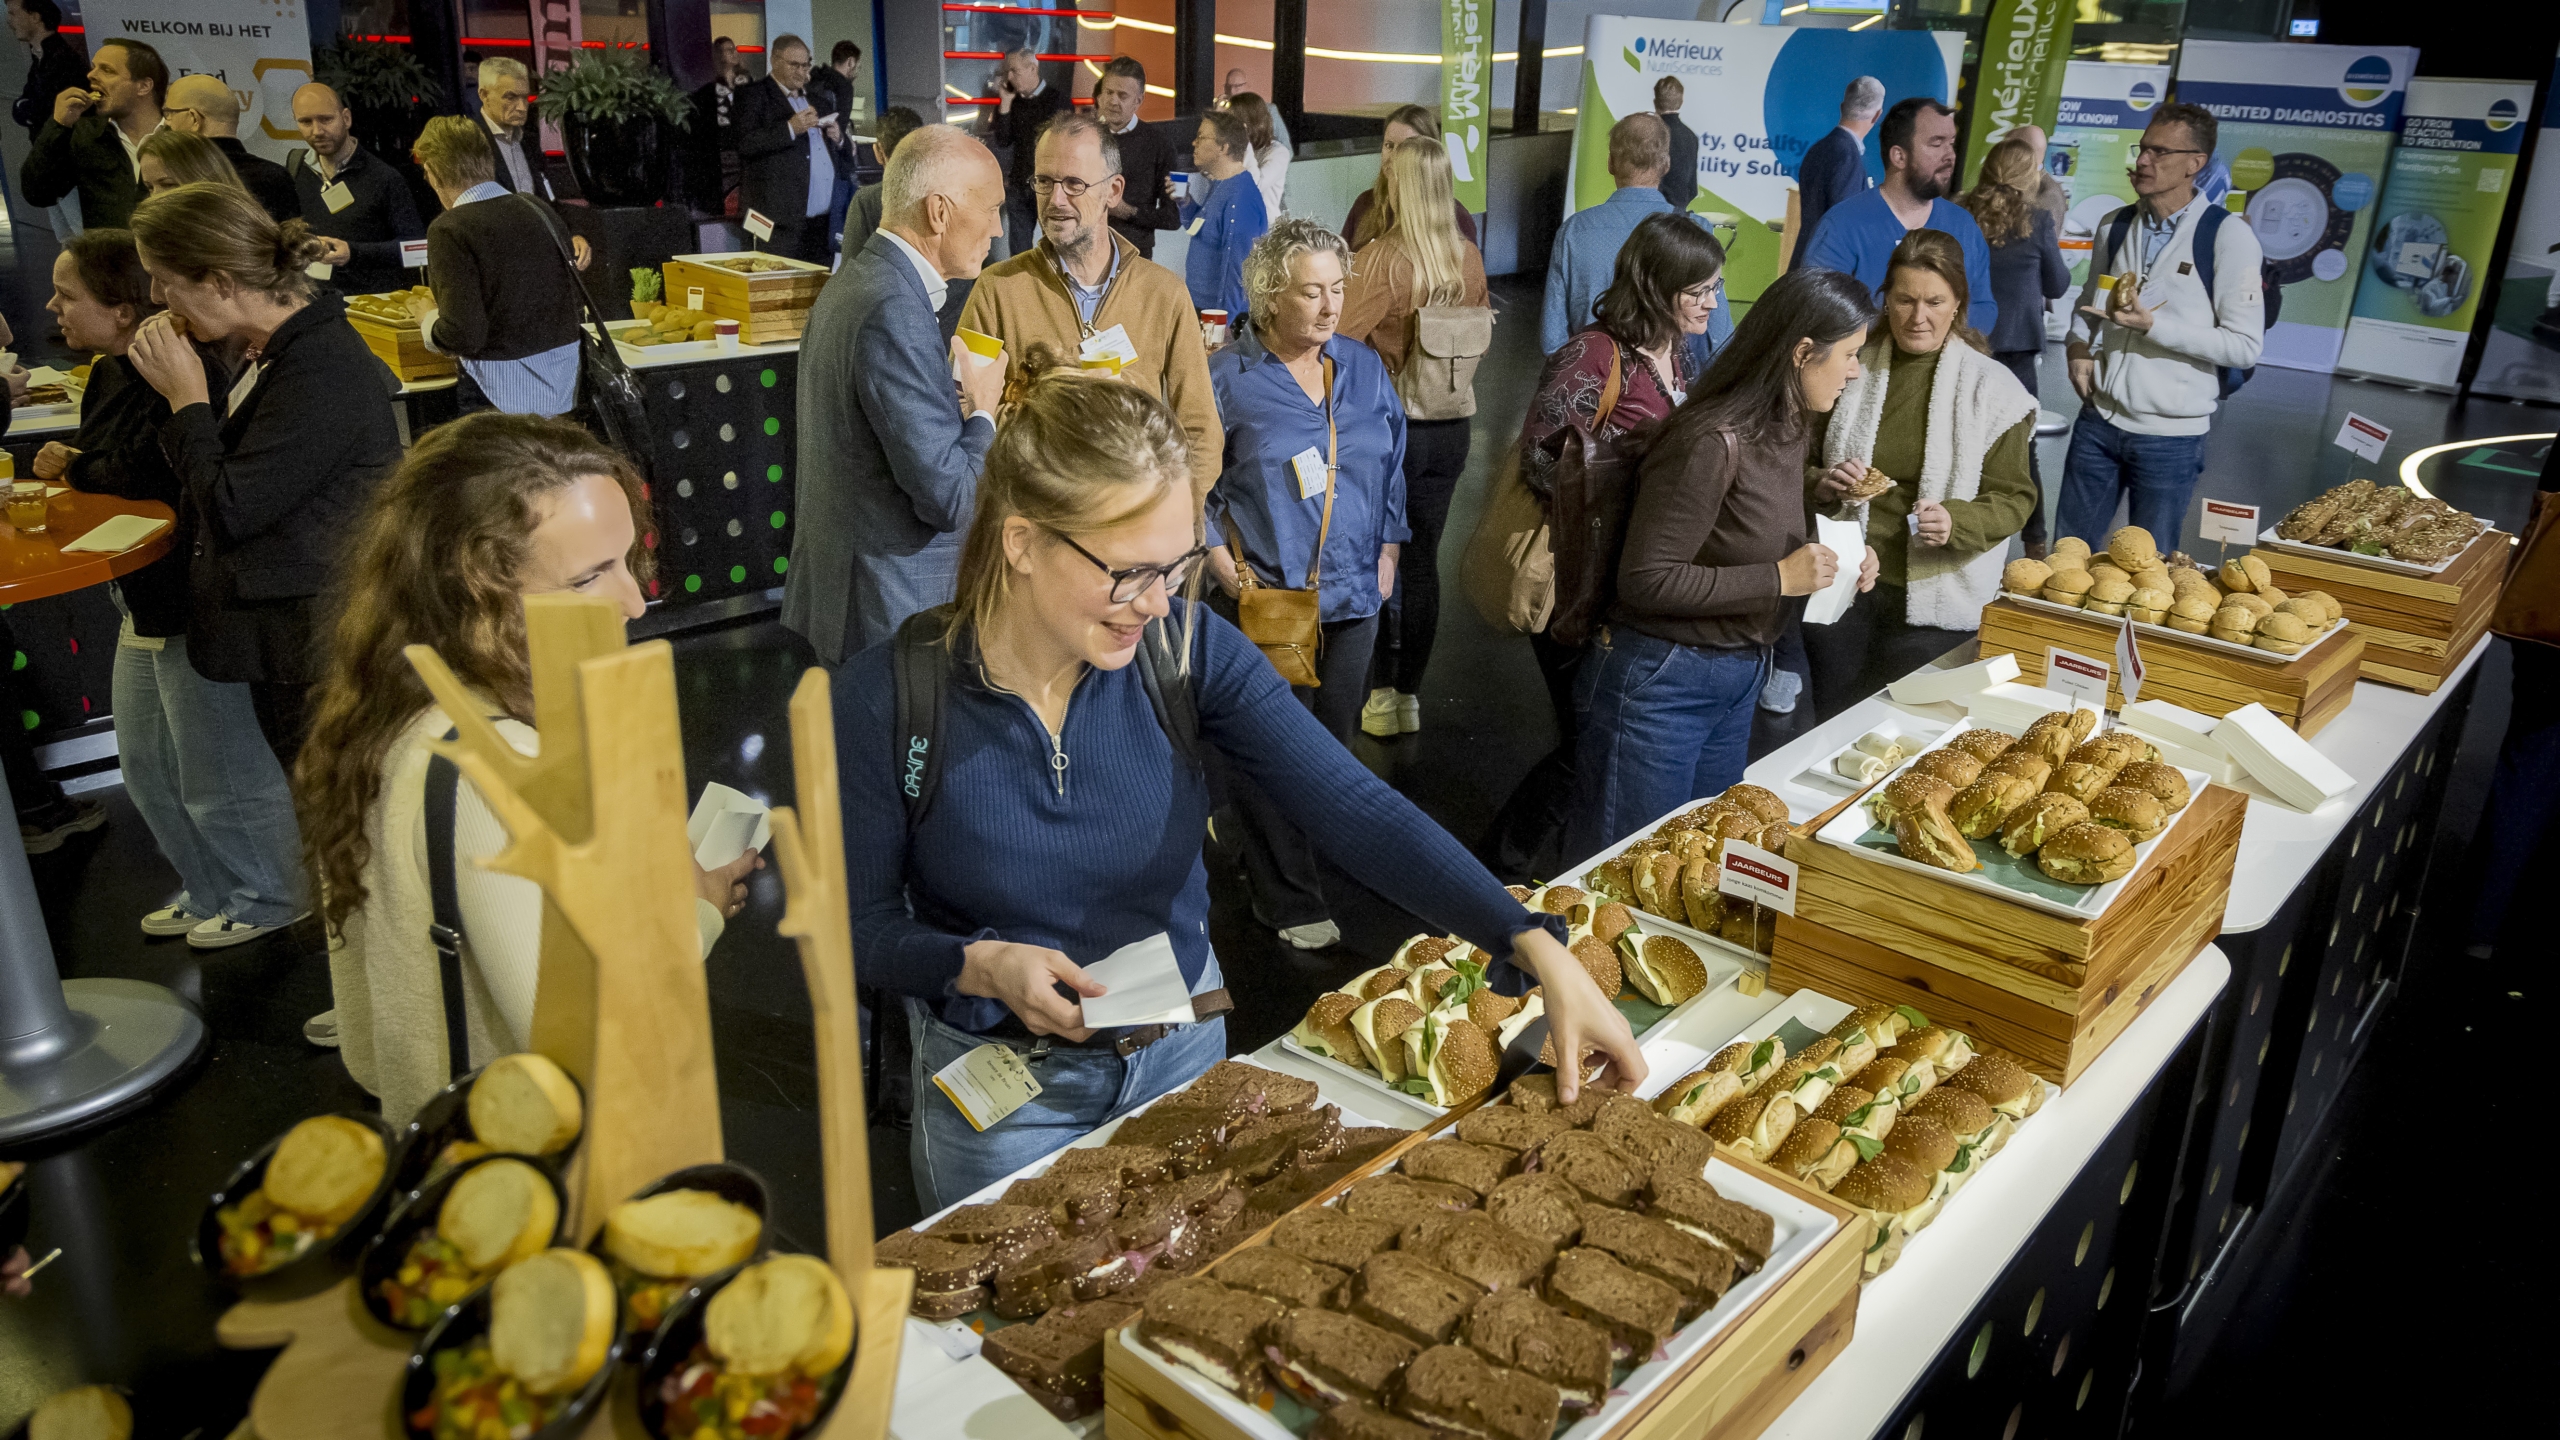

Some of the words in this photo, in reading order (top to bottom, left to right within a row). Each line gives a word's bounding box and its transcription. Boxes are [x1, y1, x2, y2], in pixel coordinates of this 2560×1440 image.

[121, 19, 204, 36] WELKOM
[208, 23, 234, 37] BIJ
[239, 25, 272, 38] HET
[1648, 37, 1724, 61] Mérieux
[1646, 59, 1723, 76] NutriSciences
[2058, 101, 2082, 112] OW
[2200, 103, 2272, 120] MENTED
[2273, 107, 2386, 127] DIAGNOSTICS
[2057, 112, 2076, 123] OU
[2076, 113, 2119, 125] KNOW!
[2405, 118, 2422, 128] GO
[2422, 119, 2453, 129] FROM
[2403, 127, 2455, 138] REACTION
[1701, 131, 1727, 151] ty,
[1733, 133, 1810, 157] Quality
[2402, 137, 2416, 146] TO
[2416, 138, 2483, 150] PREVENTION
[1700, 156, 1741, 178] ility
[2059, 660, 2102, 676] JAARBEURS
[904, 735, 929, 798] DAKINE
[1731, 860, 1783, 883] JAARBEURS
[1741, 880, 1753, 889] kaas
